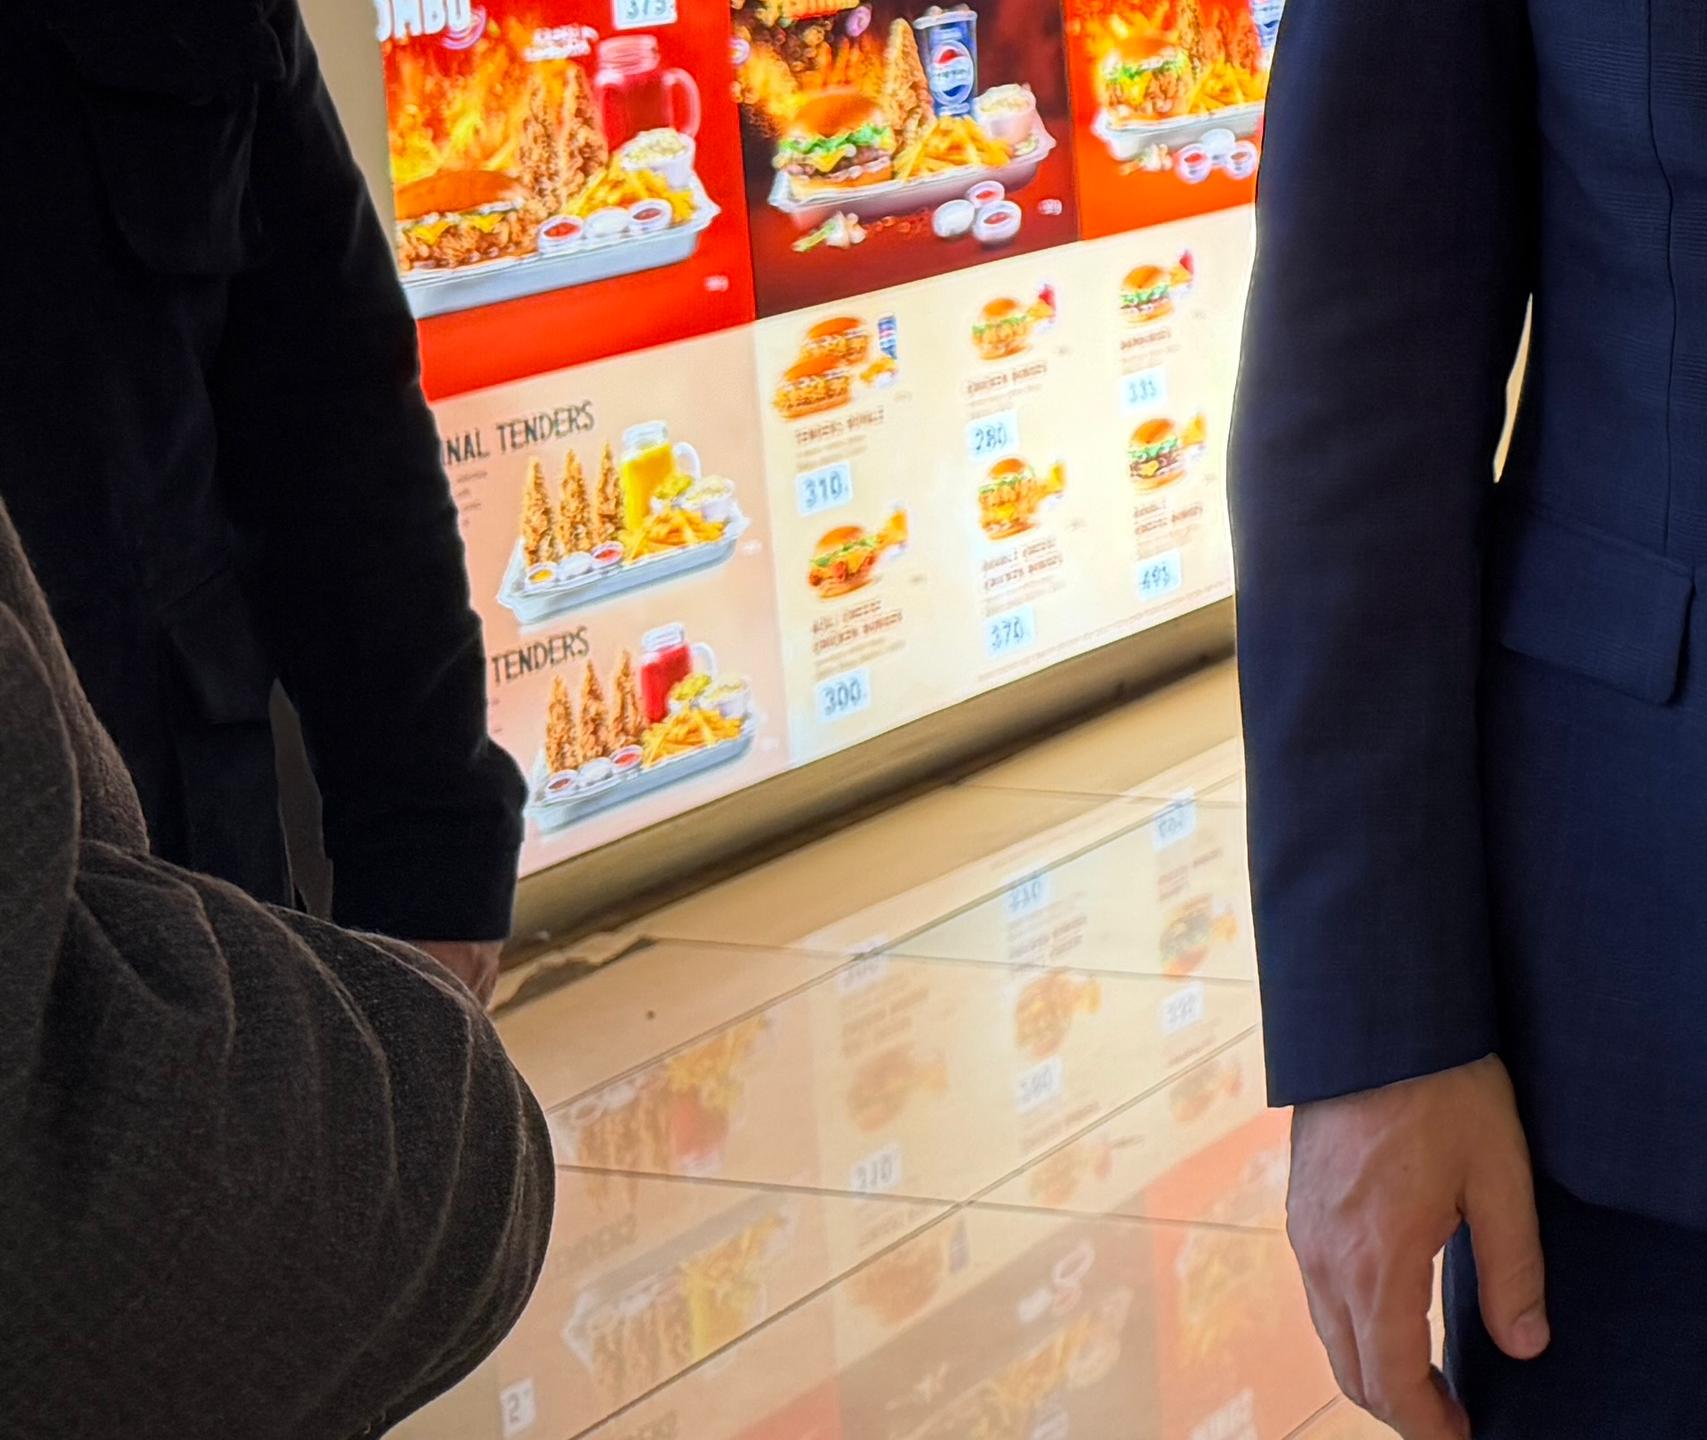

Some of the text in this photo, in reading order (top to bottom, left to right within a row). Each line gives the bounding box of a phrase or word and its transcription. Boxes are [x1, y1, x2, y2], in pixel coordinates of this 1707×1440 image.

[496, 399, 596, 454] TENDERS
[975, 422, 1008, 454] 280
[805, 471, 842, 508] 310
[491, 626, 590, 684] TENDERS
[824, 677, 862, 716] 300
